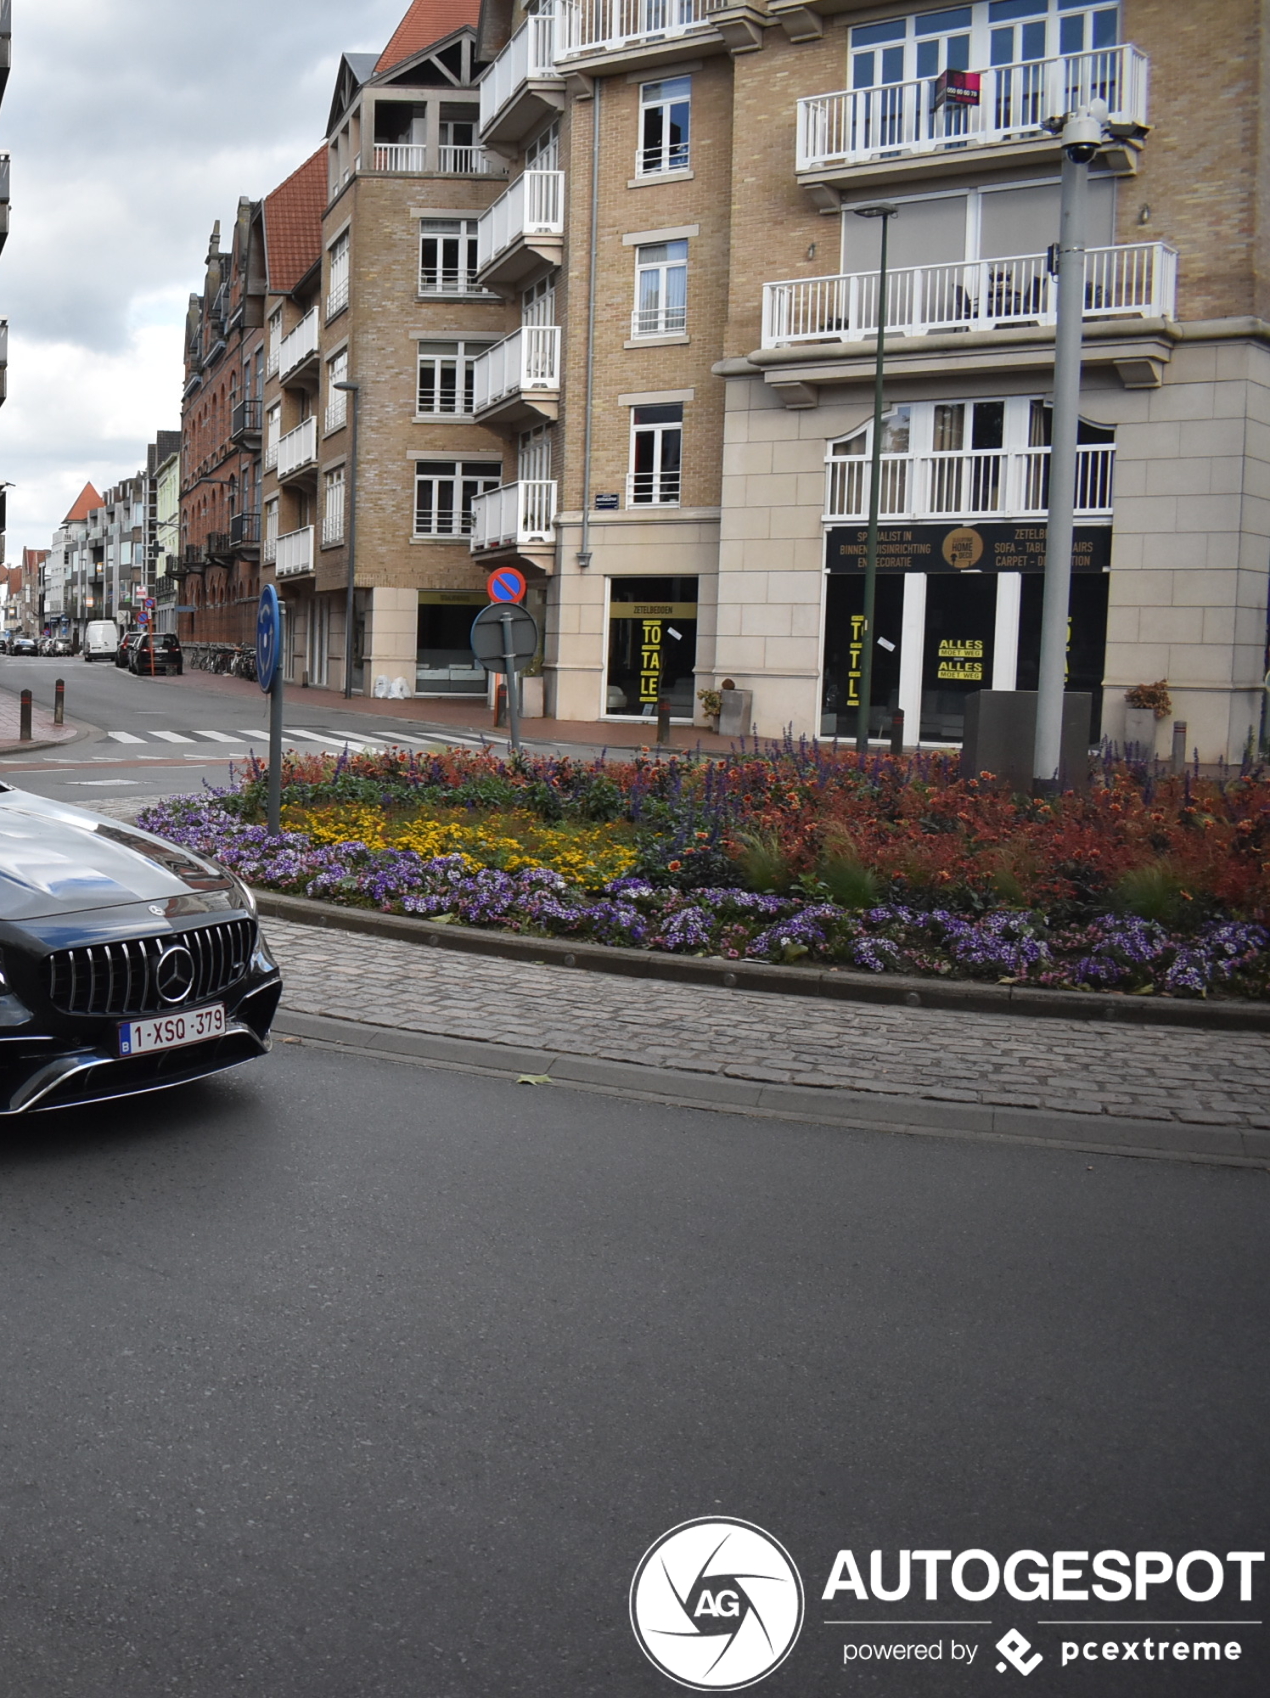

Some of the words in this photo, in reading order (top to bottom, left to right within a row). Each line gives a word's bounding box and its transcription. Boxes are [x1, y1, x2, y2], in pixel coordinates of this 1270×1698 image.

[857, 531, 901, 542] SPIALIST
[903, 531, 912, 541] IN
[840, 543, 931, 555] BINNENUISINRICHTING
[952, 542, 973, 552] HOME
[994, 542, 1016, 553] SOFA
[1025, 542, 1047, 553] TABL
[875, 557, 912, 568] ECORATIE
[995, 555, 1028, 567] CARPET
[633, 605, 673, 615] ZETELBEDDEN
[642, 626, 661, 643] TO
[939, 639, 983, 649] ALLES
[641, 652, 660, 669] TA
[938, 661, 982, 672] ALLES
[640, 677, 658, 695] LE
[134, 1009, 223, 1048] 1-XSQ-379
[121, 1041, 130, 1053] B
